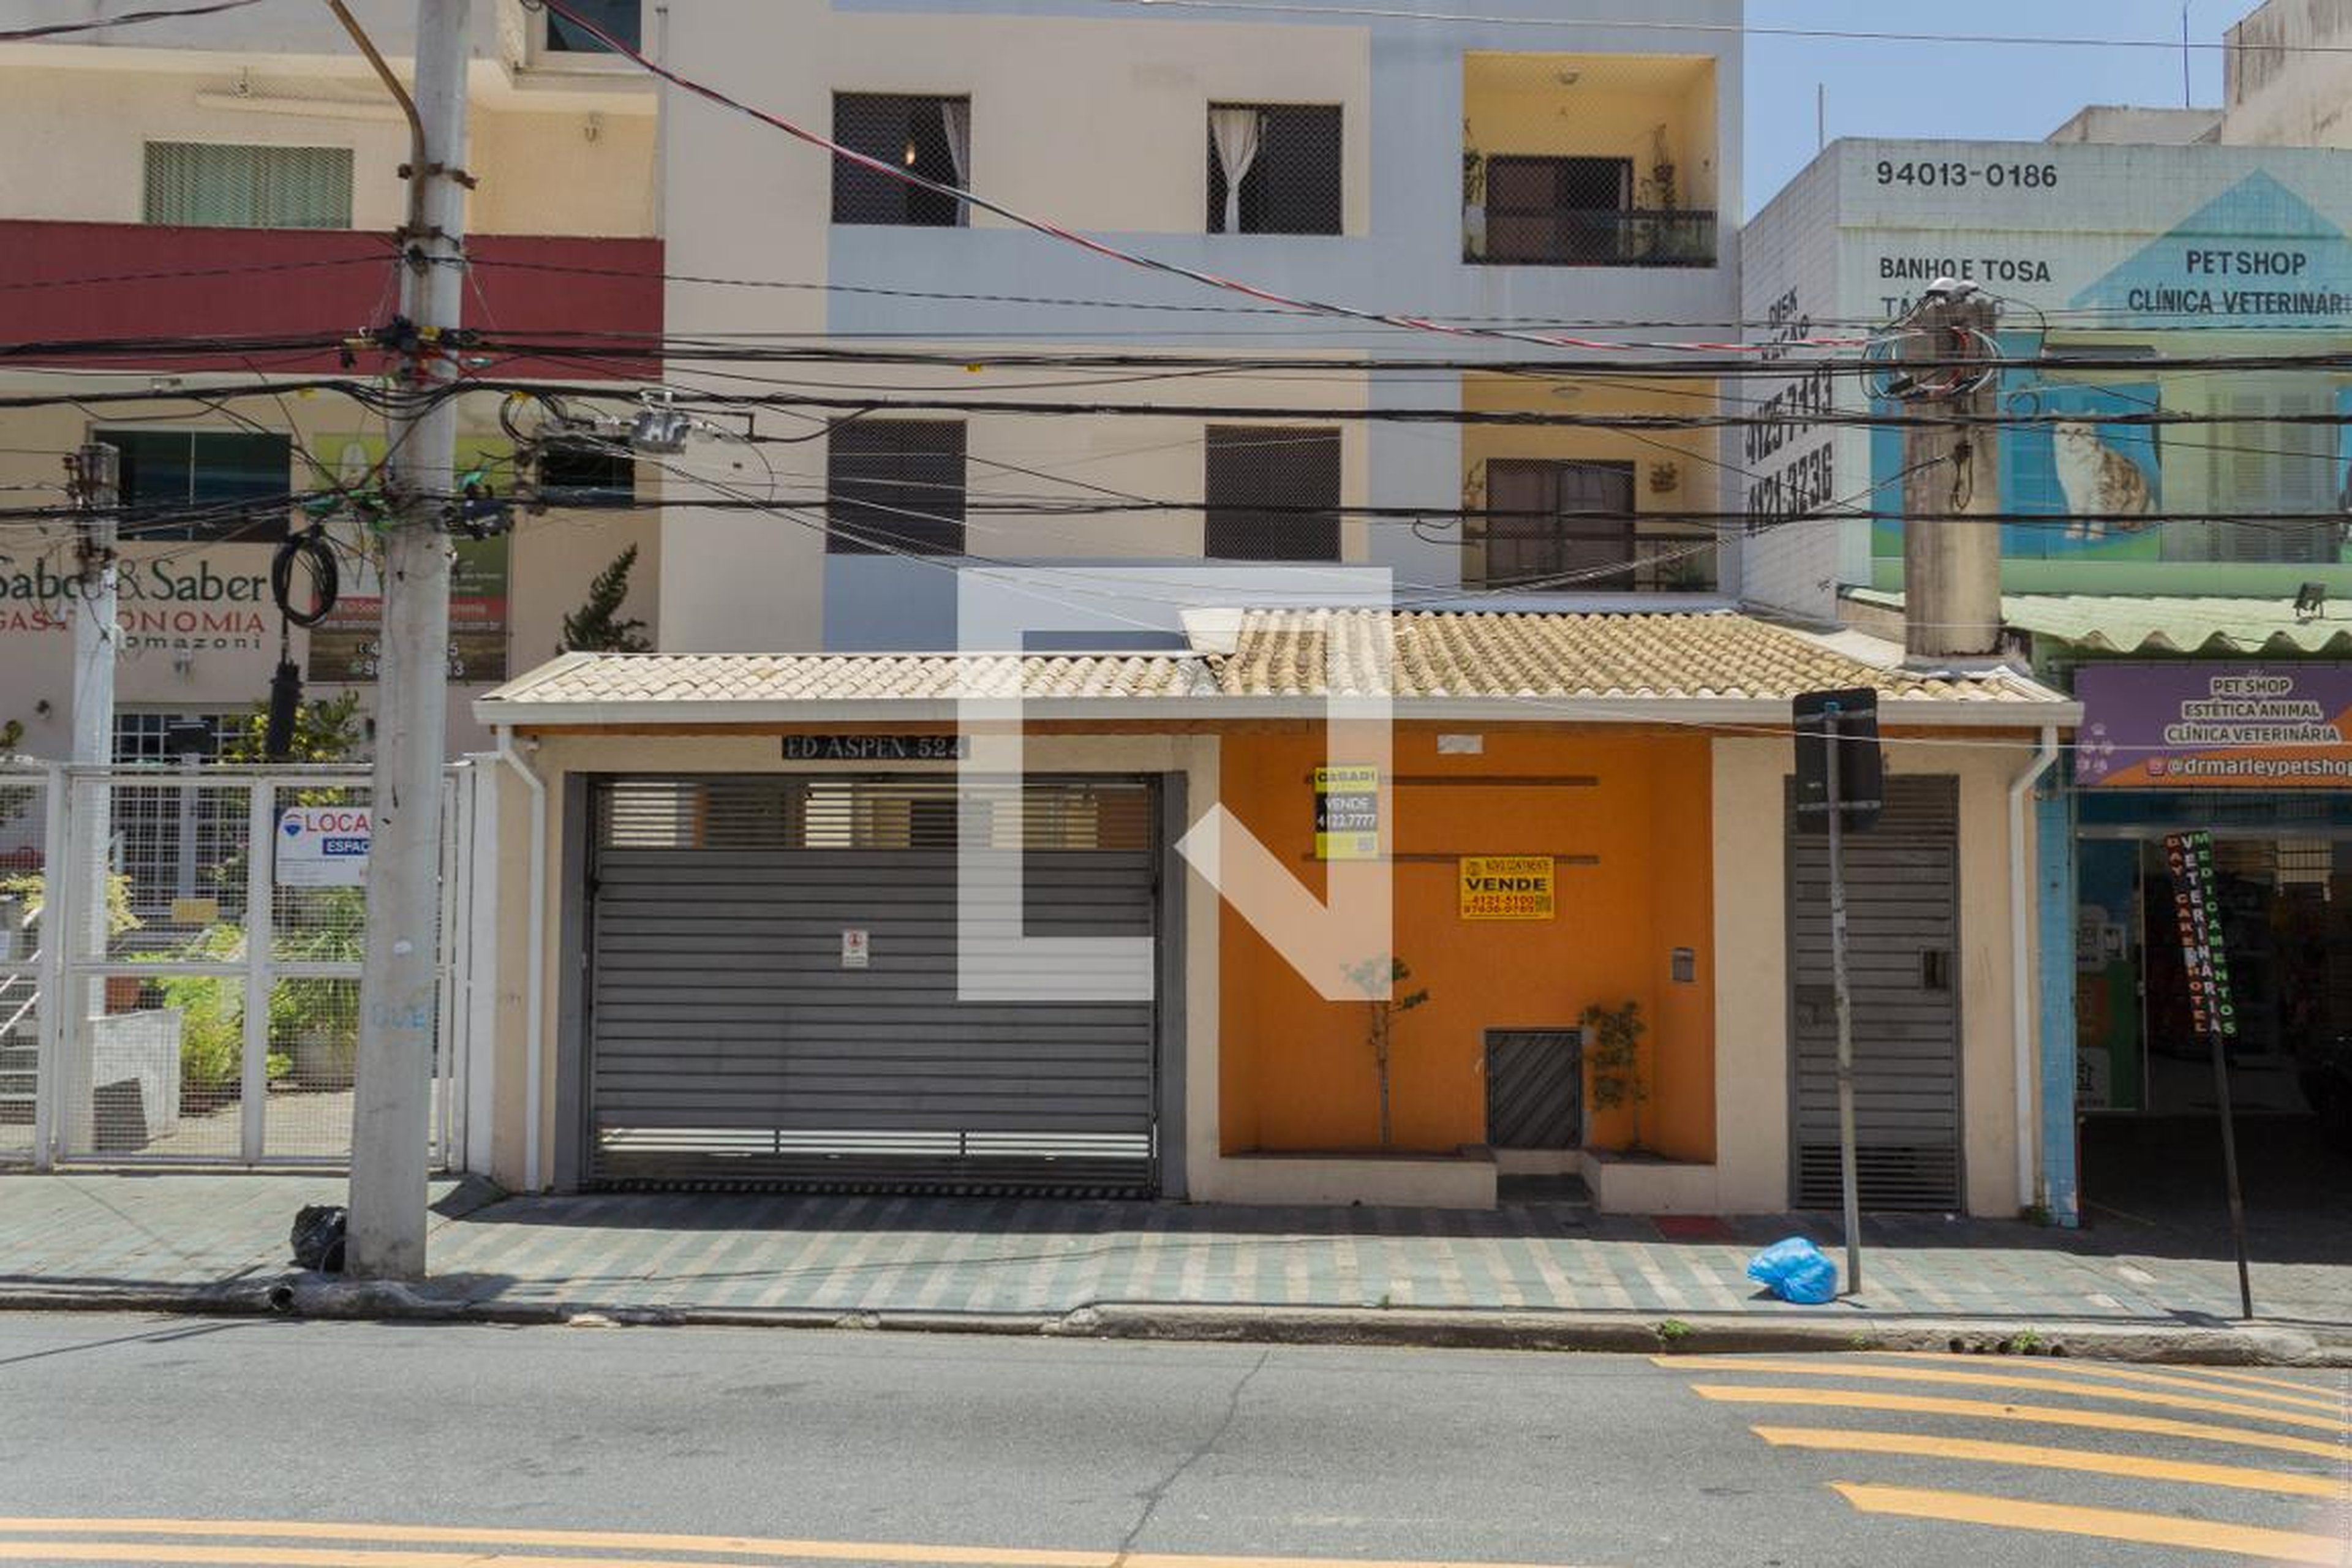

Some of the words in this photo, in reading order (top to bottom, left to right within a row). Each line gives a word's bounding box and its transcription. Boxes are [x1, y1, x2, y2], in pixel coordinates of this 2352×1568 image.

[1877, 160, 2057, 187] 94013-0186
[1880, 258, 1956, 280] BANHO
[1962, 259, 1973, 279] E
[1982, 261, 2051, 282] TOSA
[2187, 251, 2232, 274] PET
[2236, 252, 2306, 275] SHOP
[2128, 283, 2214, 314] CLÍNICA
[151, 559, 266, 601] Saber
[2214, 680, 2242, 693] PET
[2246, 680, 2290, 693] SHOP
[2185, 699, 2255, 717] ESTÉTICA
[2260, 704, 2320, 717] ANIMAL
[2167, 723, 2230, 741] CLÍNICA
[2233, 723, 2338, 742] VETERINÁRIA
[787, 737, 818, 757] ED
[827, 736, 906, 757] ASPEN
[1466, 877, 1547, 891] VENDE
